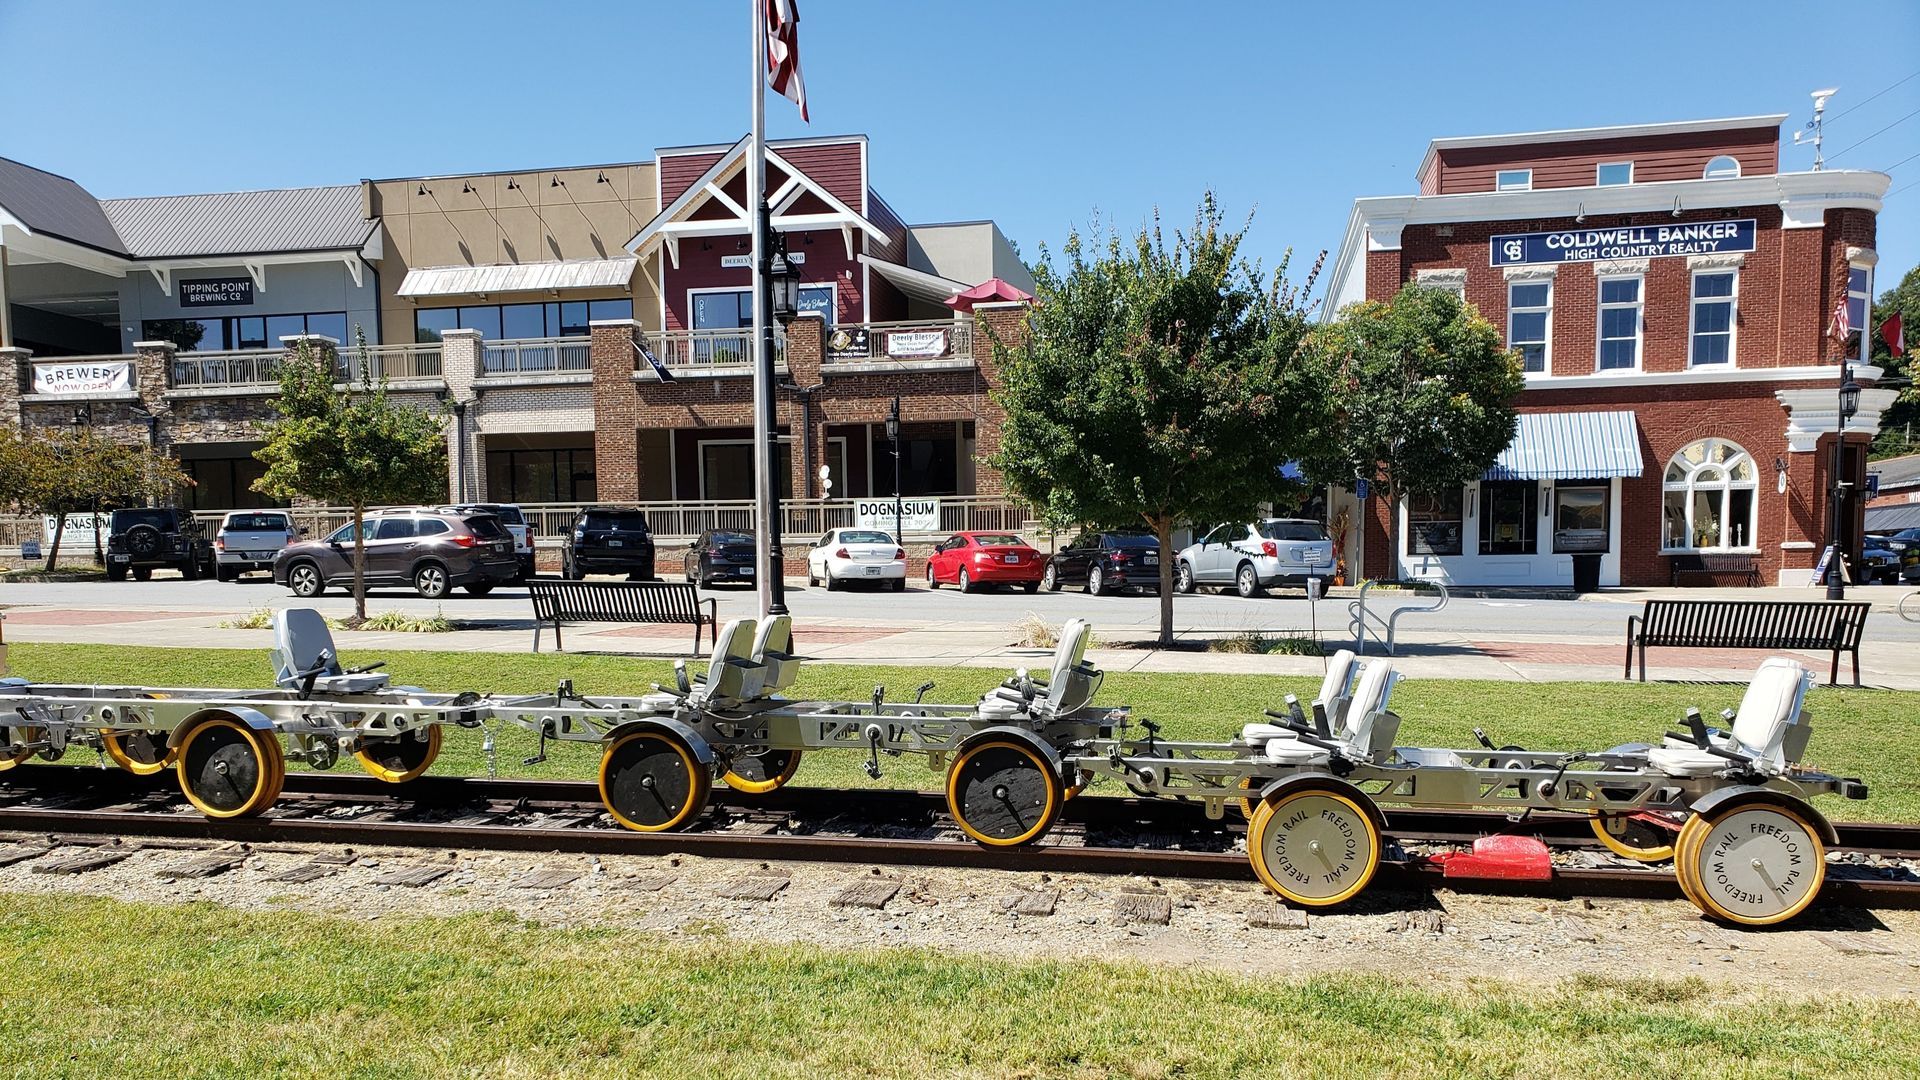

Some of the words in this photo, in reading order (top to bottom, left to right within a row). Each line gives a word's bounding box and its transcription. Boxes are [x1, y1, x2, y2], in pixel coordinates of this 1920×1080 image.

[1546, 228, 1651, 249] COLDWELL
[1658, 223, 1738, 242] BANKER
[1565, 248, 1598, 260] HIGH
[1601, 243, 1666, 258] COUNTRY
[1669, 240, 1719, 254] REALTY
[182, 283, 219, 294] TIPPING
[221, 282, 250, 292] POINT
[190, 293, 227, 302] BREWING
[45, 367, 120, 385] BREWERY
[53, 383, 80, 393] NOW
[83, 382, 112, 392] OPEN
[49, 517, 111, 530] DGNASIUM
[1282, 810, 1309, 831] RAIL
[1321, 810, 1356, 861] FREEDOM
[1715, 832, 1739, 858] RAIL
[1276, 834, 1310, 884] FREEDOM
[1750, 823, 1801, 866] FREEDOM
[1776, 870, 1800, 895] RAIL
[1323, 863, 1350, 884] RAIL
[1713, 862, 1763, 904] FREEDOM
